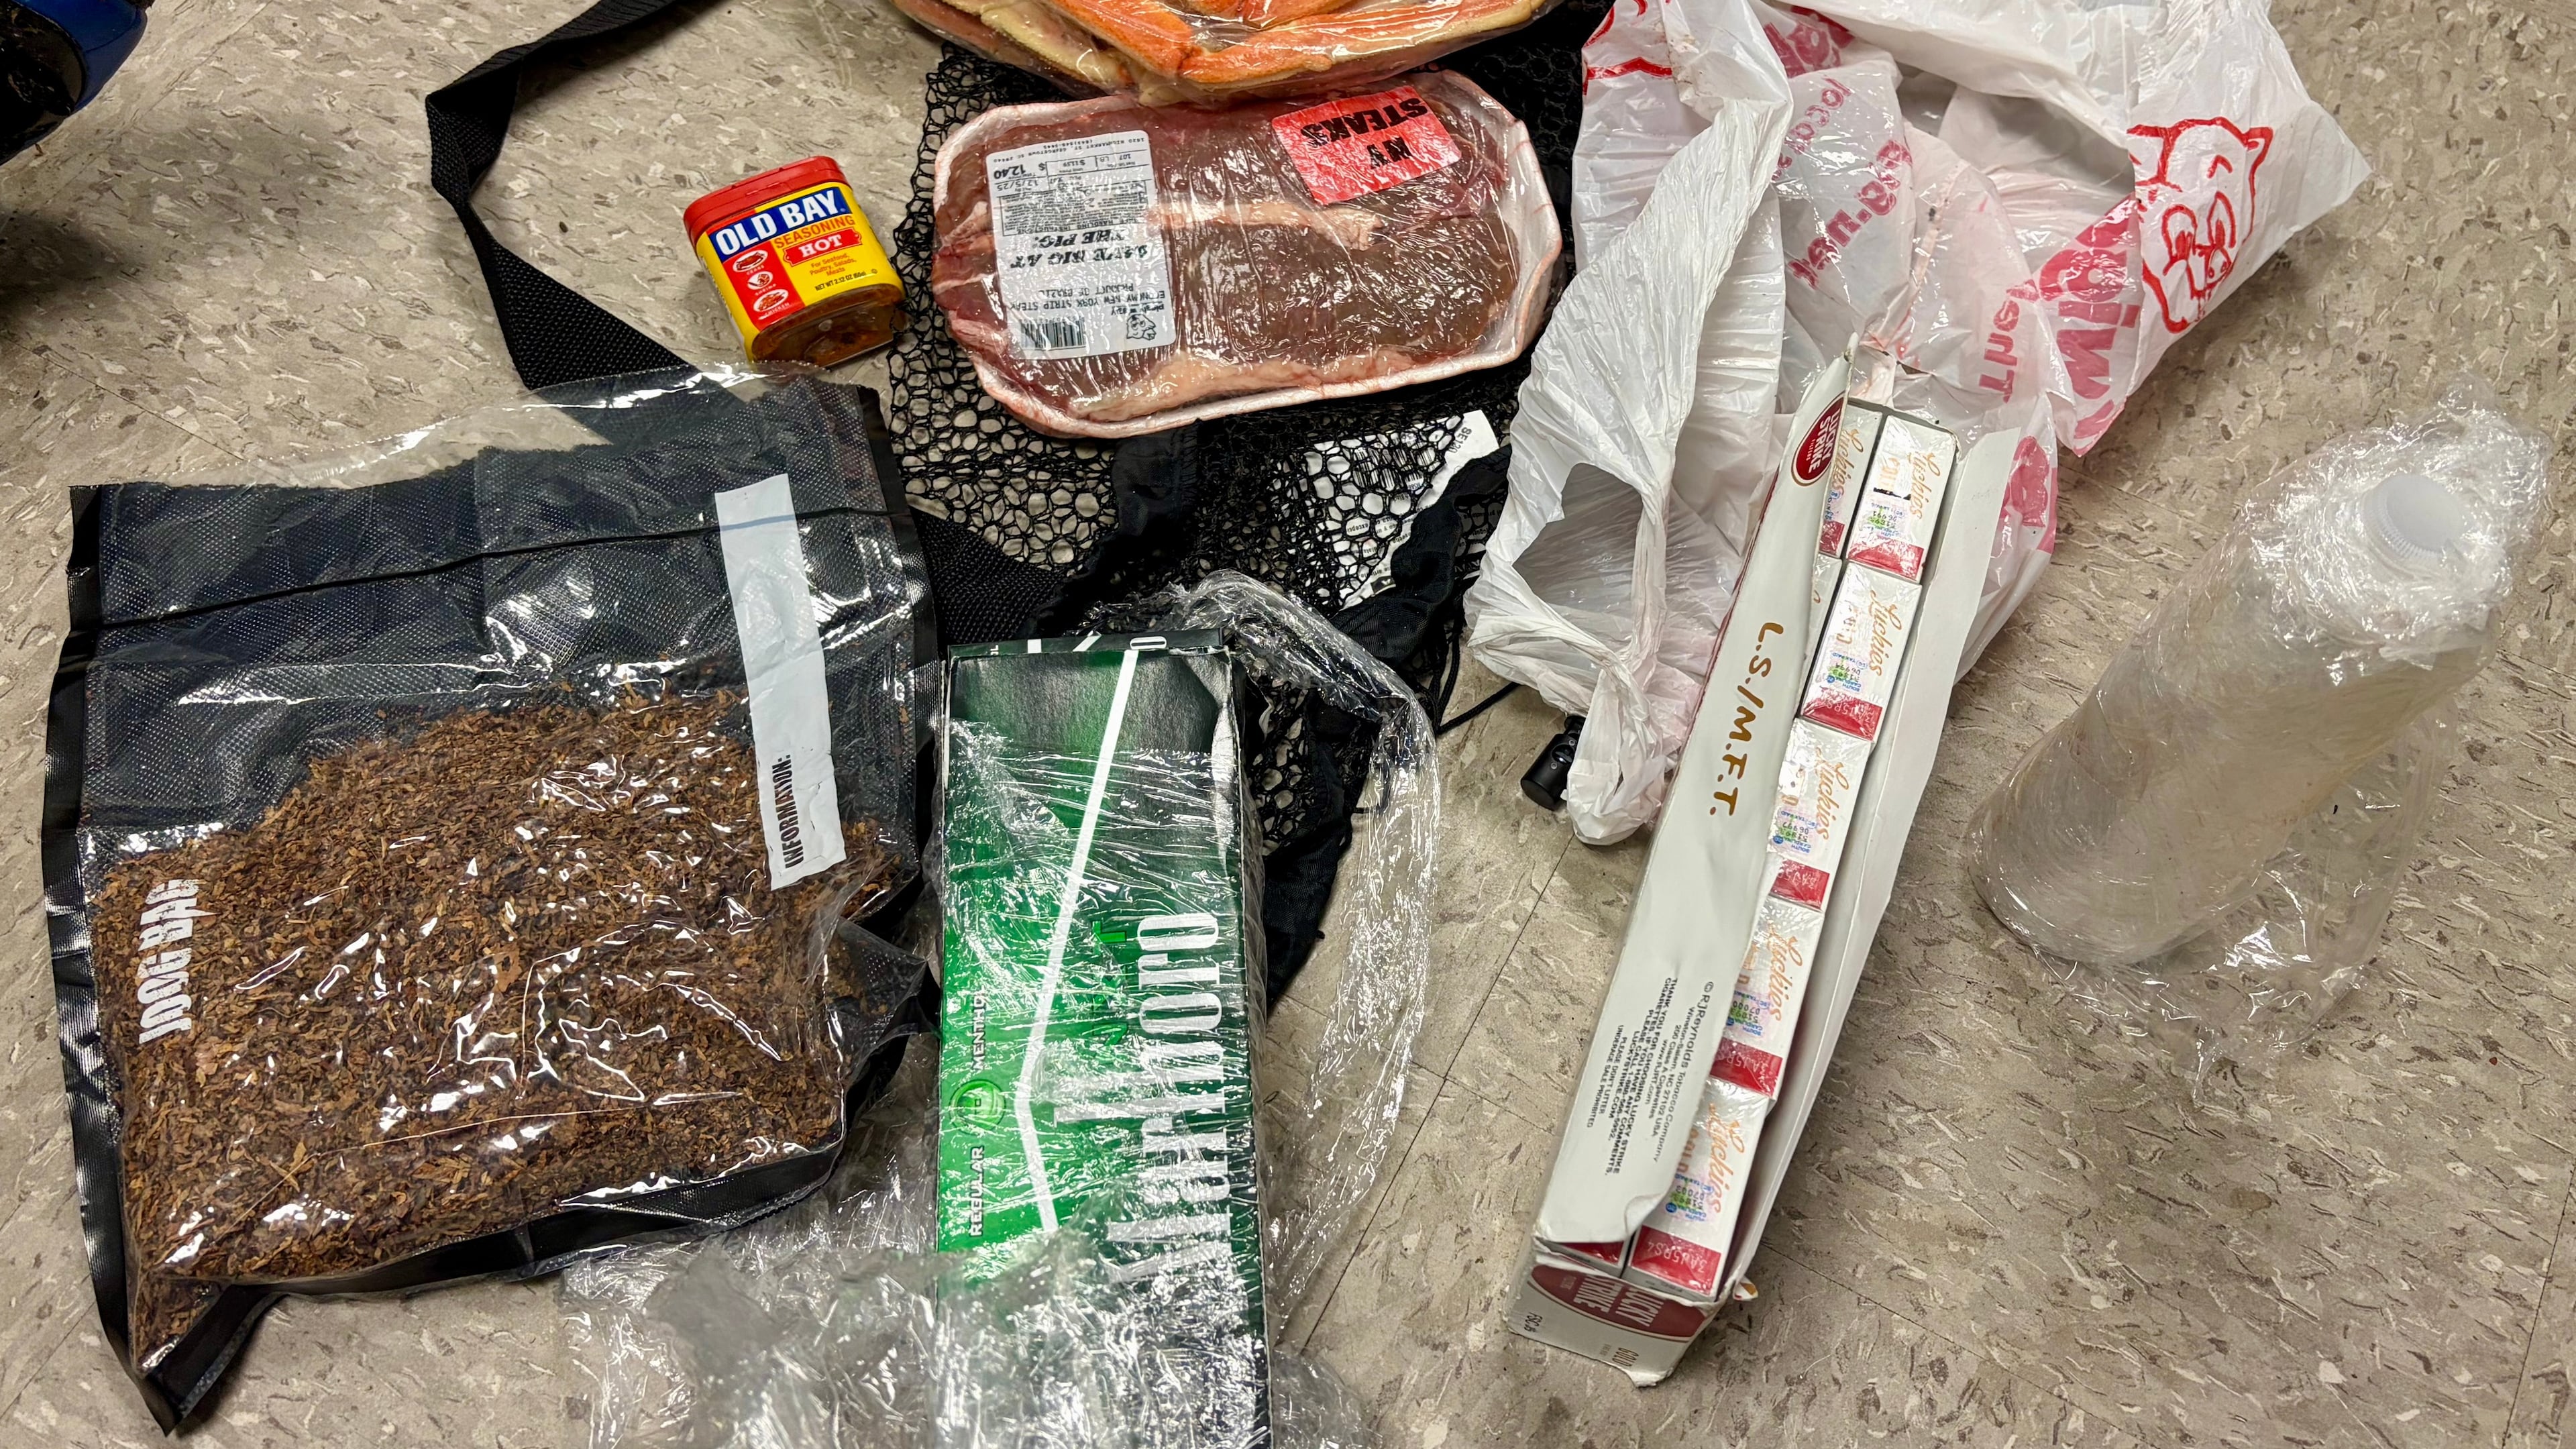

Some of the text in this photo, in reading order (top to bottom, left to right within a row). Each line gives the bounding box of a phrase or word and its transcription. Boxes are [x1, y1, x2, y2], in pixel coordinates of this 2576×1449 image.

[1299, 97, 1427, 148] STEAKS
[1366, 137, 1411, 168] NY
[996, 178, 1038, 191] 12/5/25
[716, 191, 842, 256] OLD BAY
[774, 215, 855, 250] SEASONING
[798, 235, 843, 258] HOT
[1034, 231, 1078, 251] PIG.
[822, 254, 849, 266] Seafood,
[826, 266, 846, 277] Meats
[1042, 298, 1071, 311] STRIP
[1808, 415, 1833, 473] STRIKE
[1821, 407, 1844, 461] LUCKY
[1908, 451, 1940, 520] Luckies
[1868, 590, 1902, 677] Luckies
[1841, 684, 1860, 692] SOUTH
[1709, 622, 1784, 816] L.S./M.F.T.
[768, 754, 806, 869] INFORMATION:
[1815, 747, 1849, 840] Luckies
[1790, 843, 1810, 853] SOUTH
[138, 877, 213, 951] BAG
[1767, 920, 1803, 1021] Luckies
[971, 986, 986, 1070] MENTHOL
[1638, 1008, 1654, 1044] PLEASE
[1644, 1035, 1652, 1044] IF
[1586, 1023, 1623, 1128] UNDERAGE SALE PROHIBITED
[1598, 1036, 1627, 1114] PLEASE DON'T LITTER
[1607, 1030, 1640, 1120] LUCKYSTRIKE.COM
[1612, 977, 1678, 1173] THANK YOU FOR CHOOSING LUCKY STRIKE
[1629, 1044, 1642, 1069] CALL
[1637, 1045, 1648, 1067] YOU
[1647, 1024, 1681, 1120] 200 Class A Cigarettes
[1629, 1069, 1641, 1093] HAVE
[1665, 1073, 1675, 1088] NC
[1667, 1070, 1685, 1113] Tobacco
[1623, 1095, 1633, 1116] ANY
[1650, 1117, 1662, 1138] USA
[1652, 1113, 1673, 1163] Company
[1709, 1102, 1745, 1214] Luckies
[969, 1145, 984, 1236] REGULAR
[1611, 1346, 1640, 1368] GOLD
